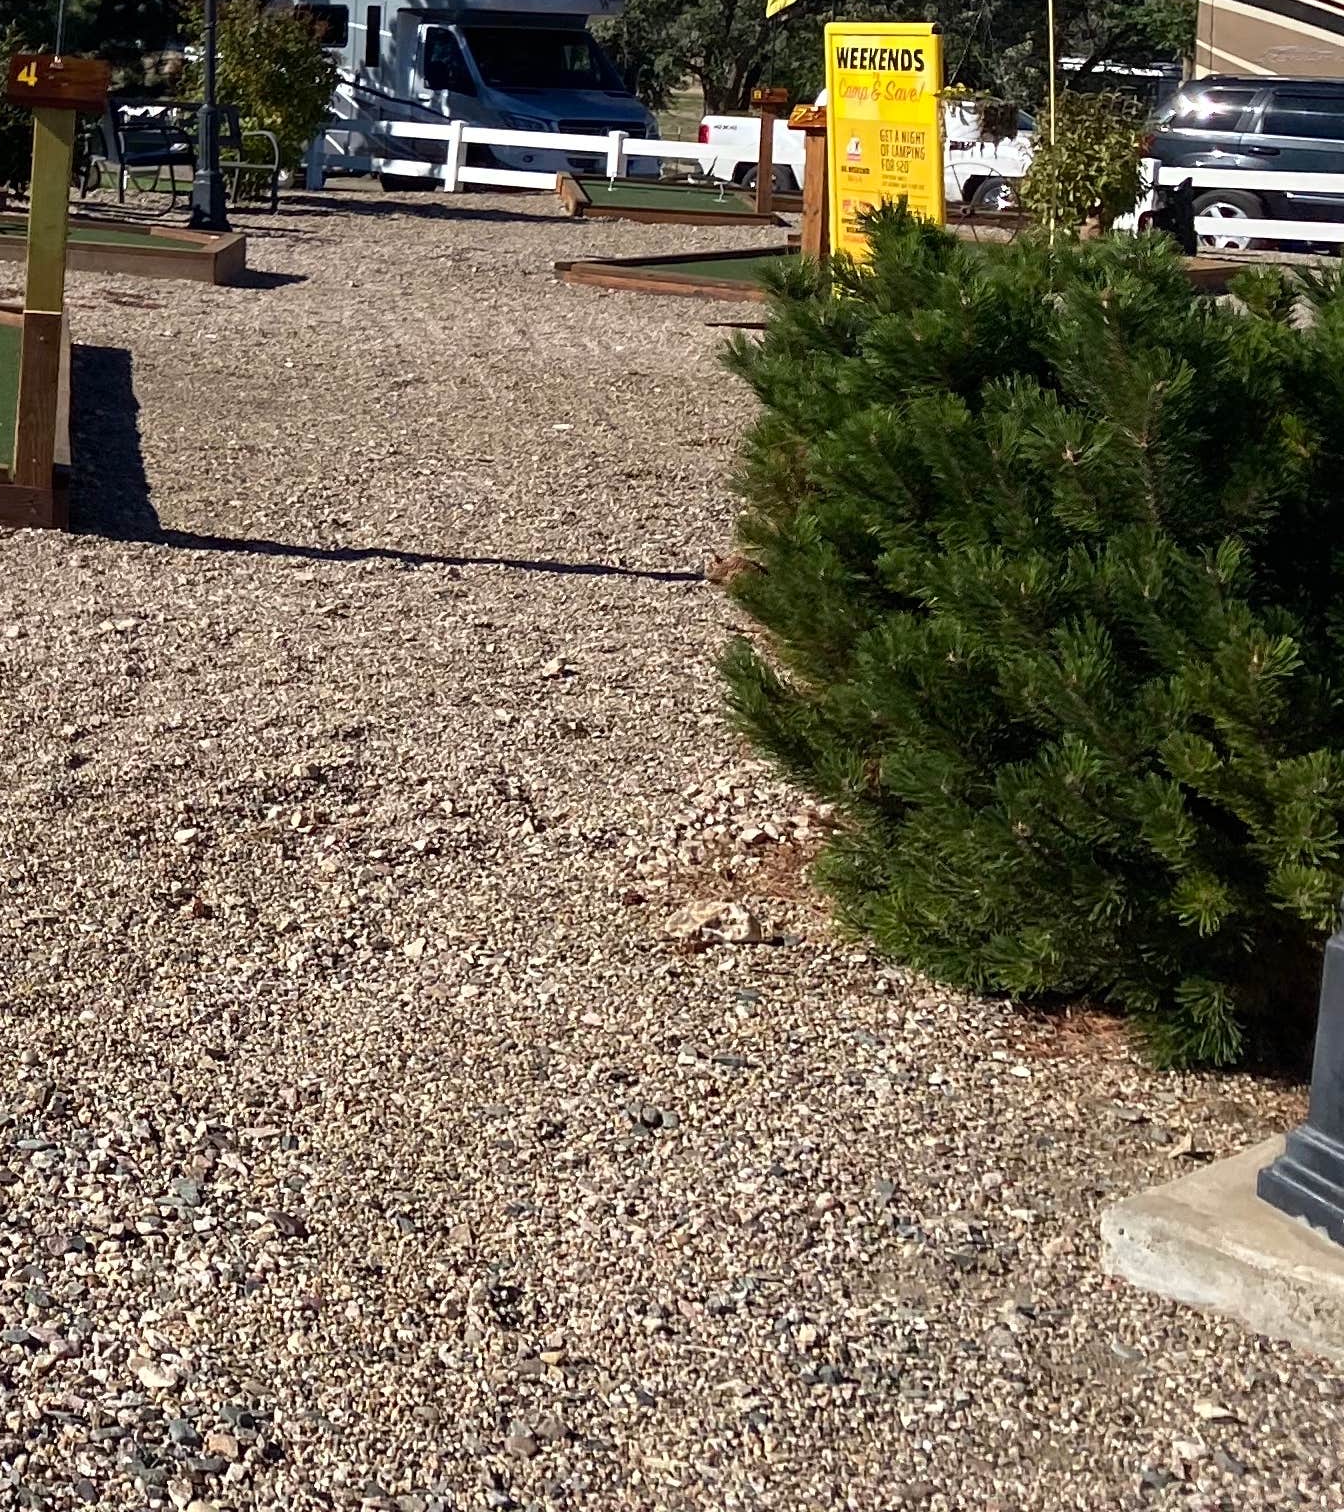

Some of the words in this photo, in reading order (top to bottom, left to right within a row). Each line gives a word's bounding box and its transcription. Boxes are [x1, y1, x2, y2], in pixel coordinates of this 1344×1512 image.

[836, 47, 925, 72] WEEKENDS
[17, 61, 38, 87] 4
[839, 77, 869, 103] Camp
[879, 129, 893, 142] GET
[894, 130, 900, 143] A
[901, 131, 926, 145] NIGHT
